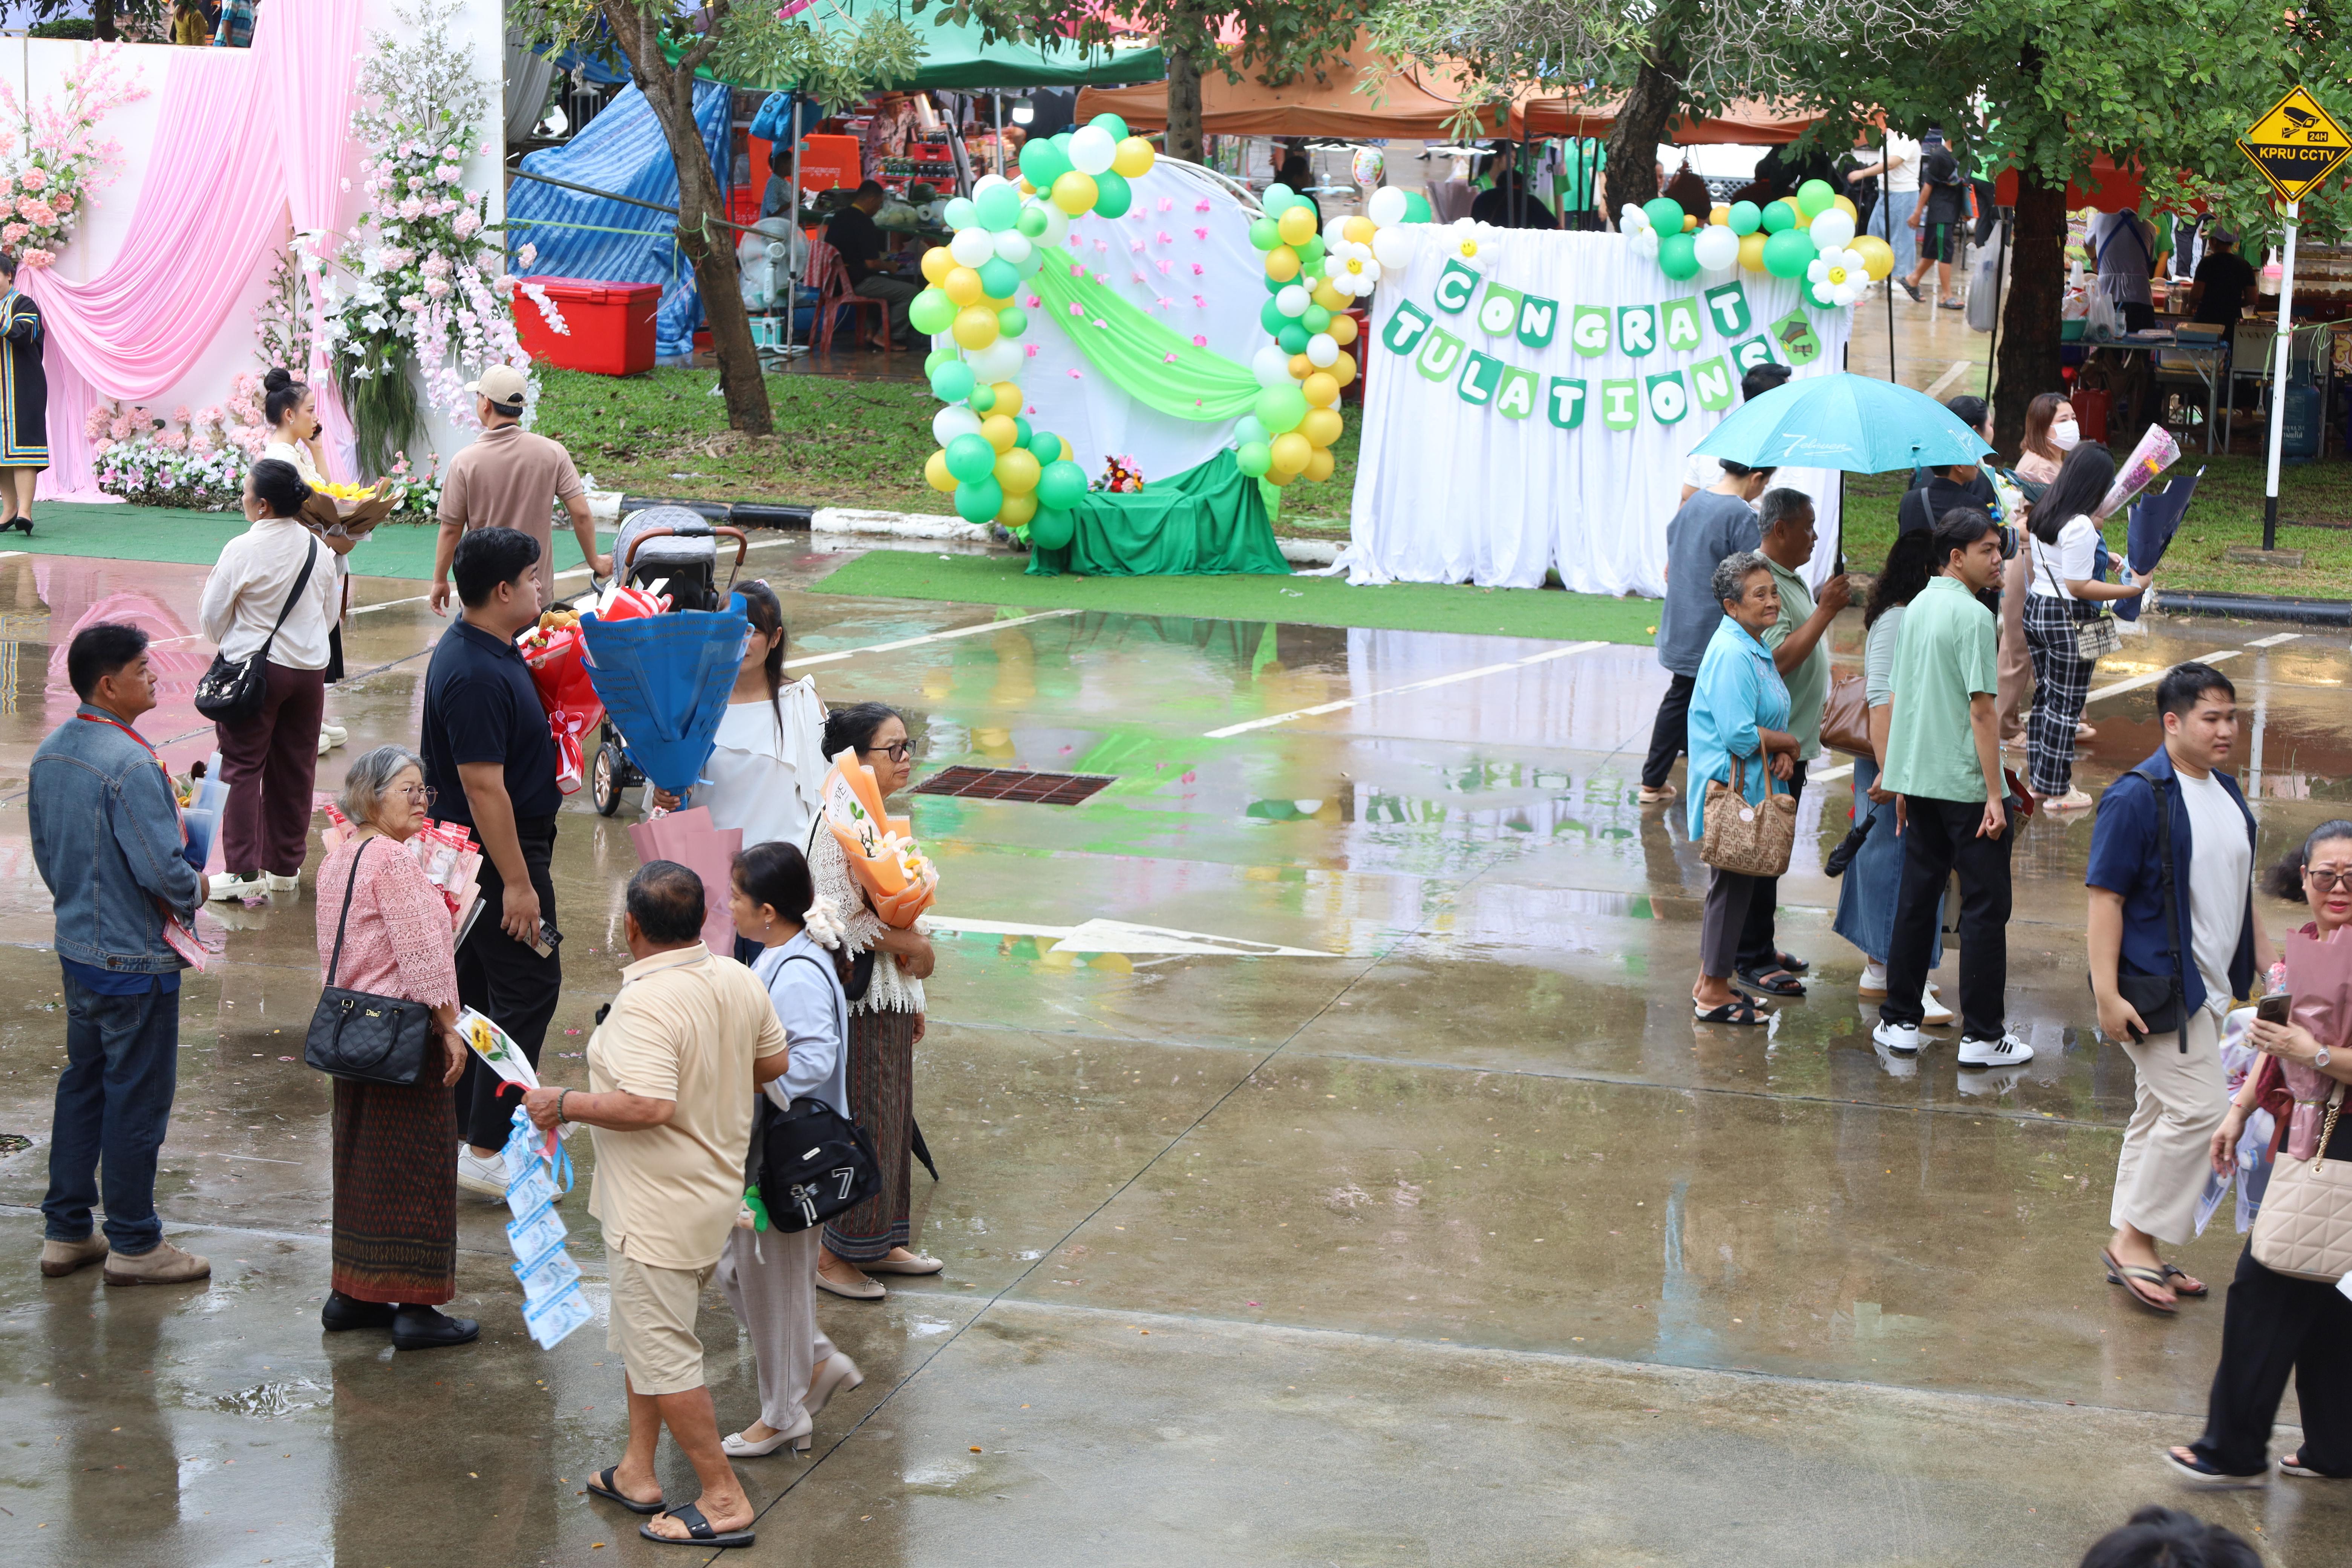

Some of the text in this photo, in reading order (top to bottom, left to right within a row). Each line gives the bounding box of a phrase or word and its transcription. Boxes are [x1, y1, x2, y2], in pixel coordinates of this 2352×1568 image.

[2259, 147, 2335, 161] KPRU CCTV
[1435, 271, 1741, 351] CONGRAT
[831, 1167, 854, 1199] 7
